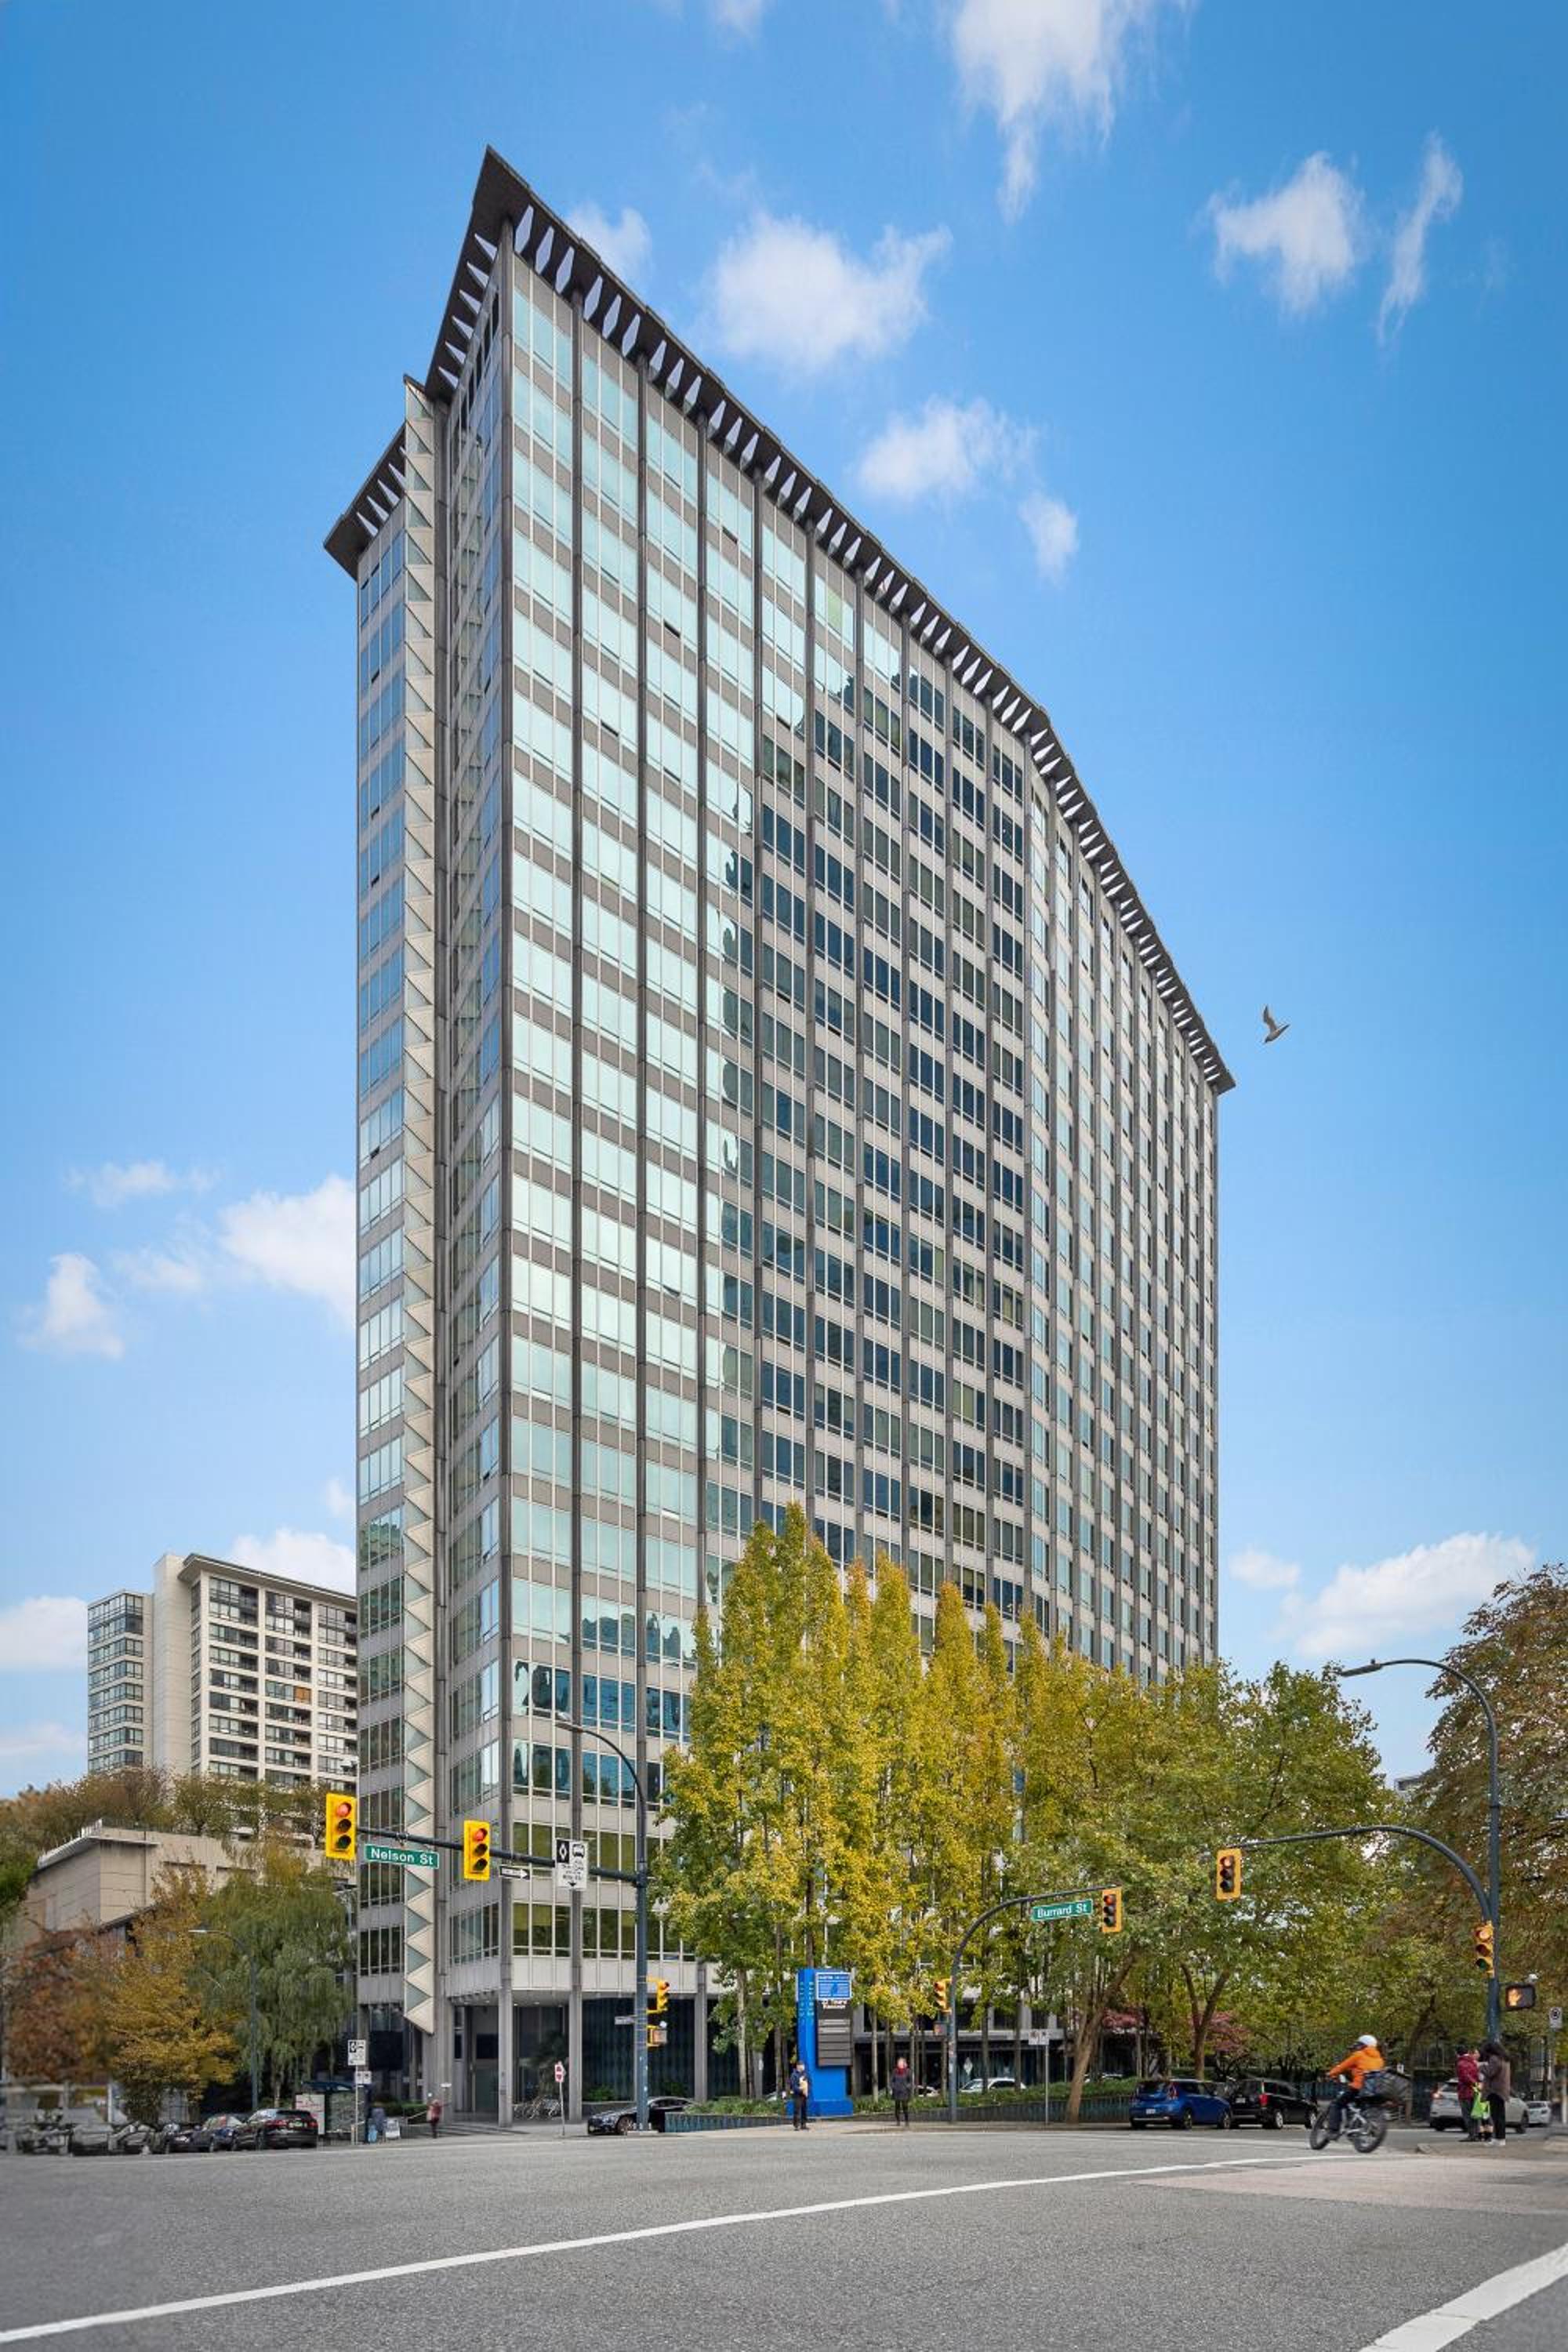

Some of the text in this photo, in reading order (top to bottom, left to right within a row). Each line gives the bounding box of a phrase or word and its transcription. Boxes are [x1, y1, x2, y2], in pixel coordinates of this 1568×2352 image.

[371, 1847, 434, 1865] Nelson St
[1037, 1903, 1087, 1918] Burrard St
